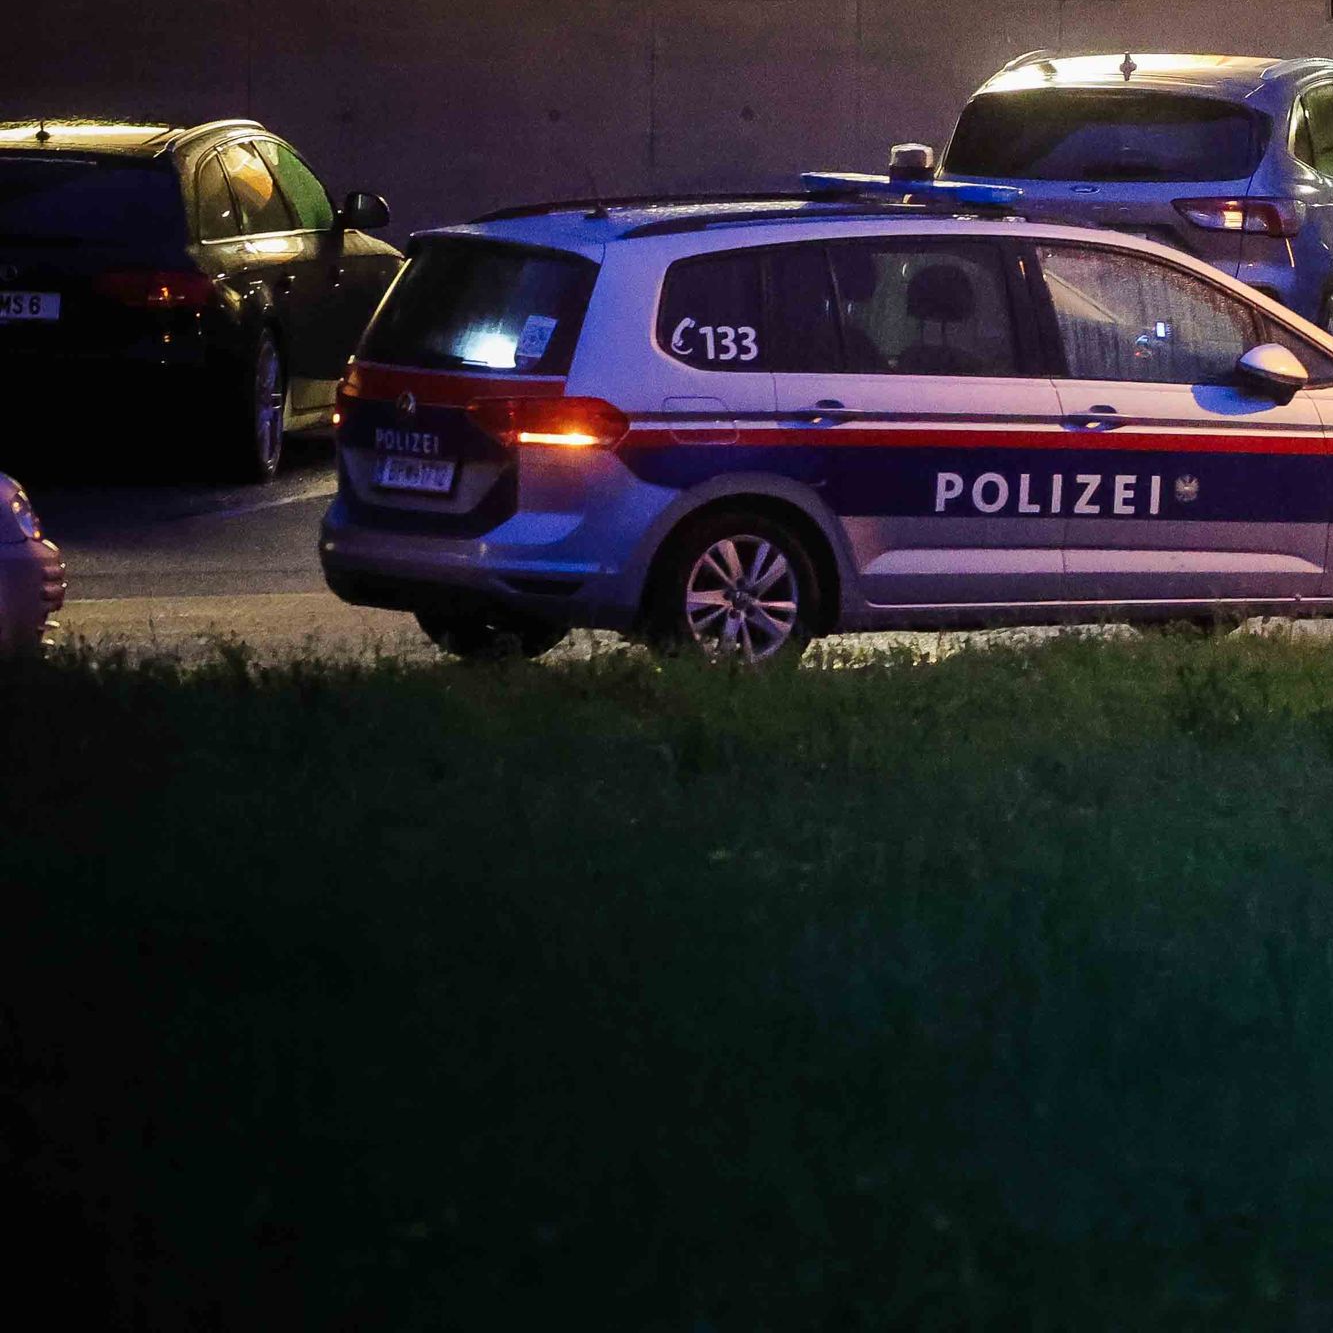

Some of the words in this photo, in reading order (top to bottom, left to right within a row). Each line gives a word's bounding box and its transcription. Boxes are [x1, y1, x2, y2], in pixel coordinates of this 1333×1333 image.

[699, 326, 758, 361] 133
[376, 427, 439, 454] POLIZEI
[935, 471, 1161, 515] POLIZEI
